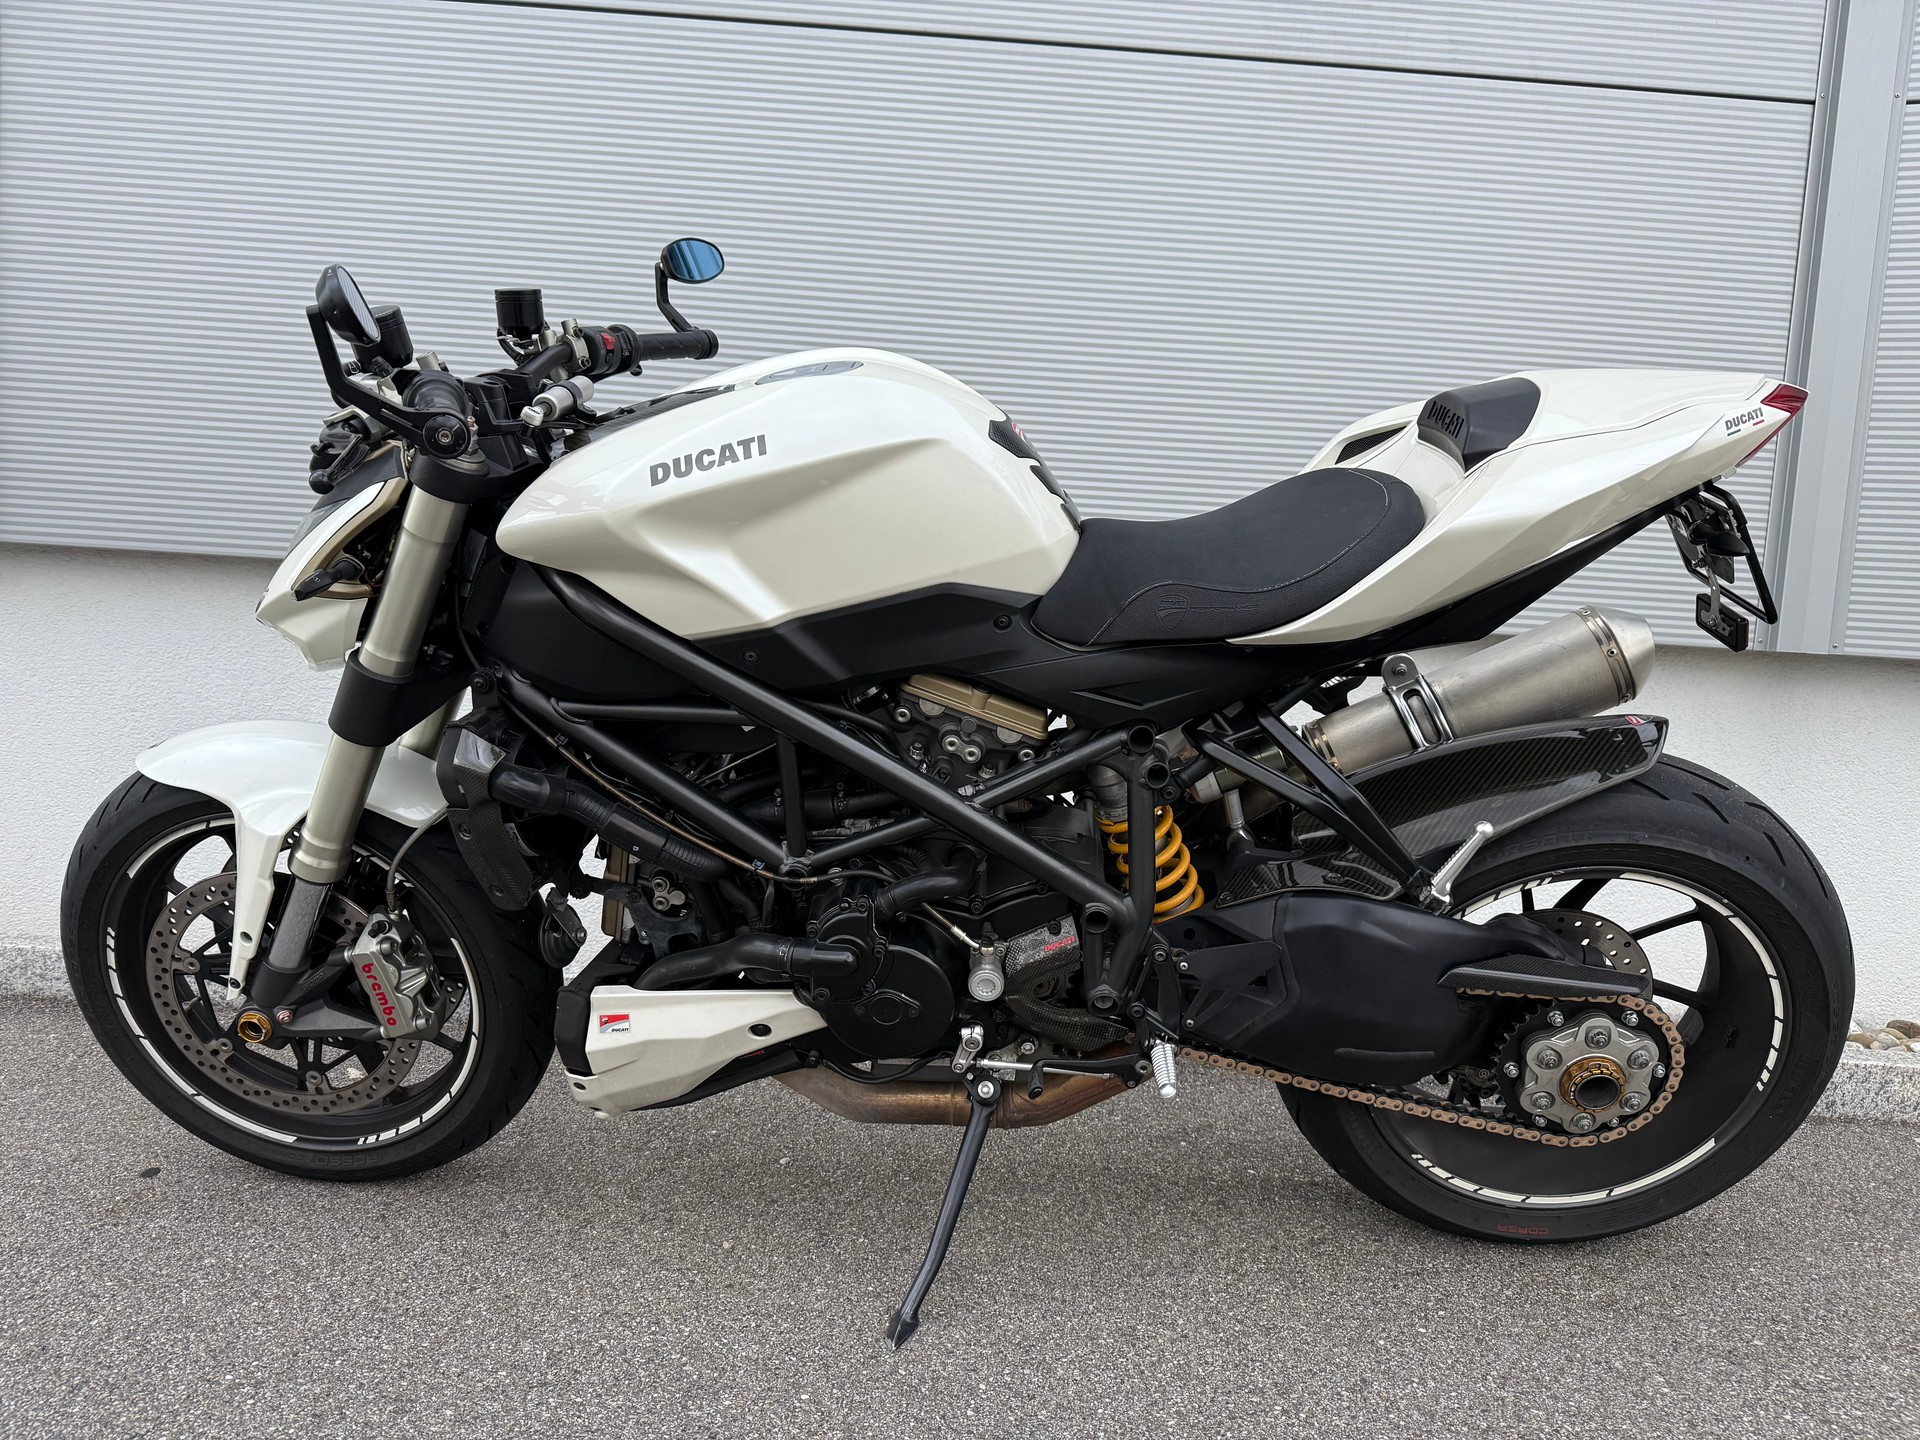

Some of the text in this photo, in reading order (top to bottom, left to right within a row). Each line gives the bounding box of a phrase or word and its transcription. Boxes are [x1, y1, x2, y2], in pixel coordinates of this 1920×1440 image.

[1427, 400, 1465, 439] DUCATI
[1725, 407, 1764, 431] DUCATI
[649, 433, 767, 487] DUCATI
[1044, 935, 1077, 953] DUCATI
[361, 962, 398, 1027] brembo
[1497, 1224, 1549, 1236] CORSA
